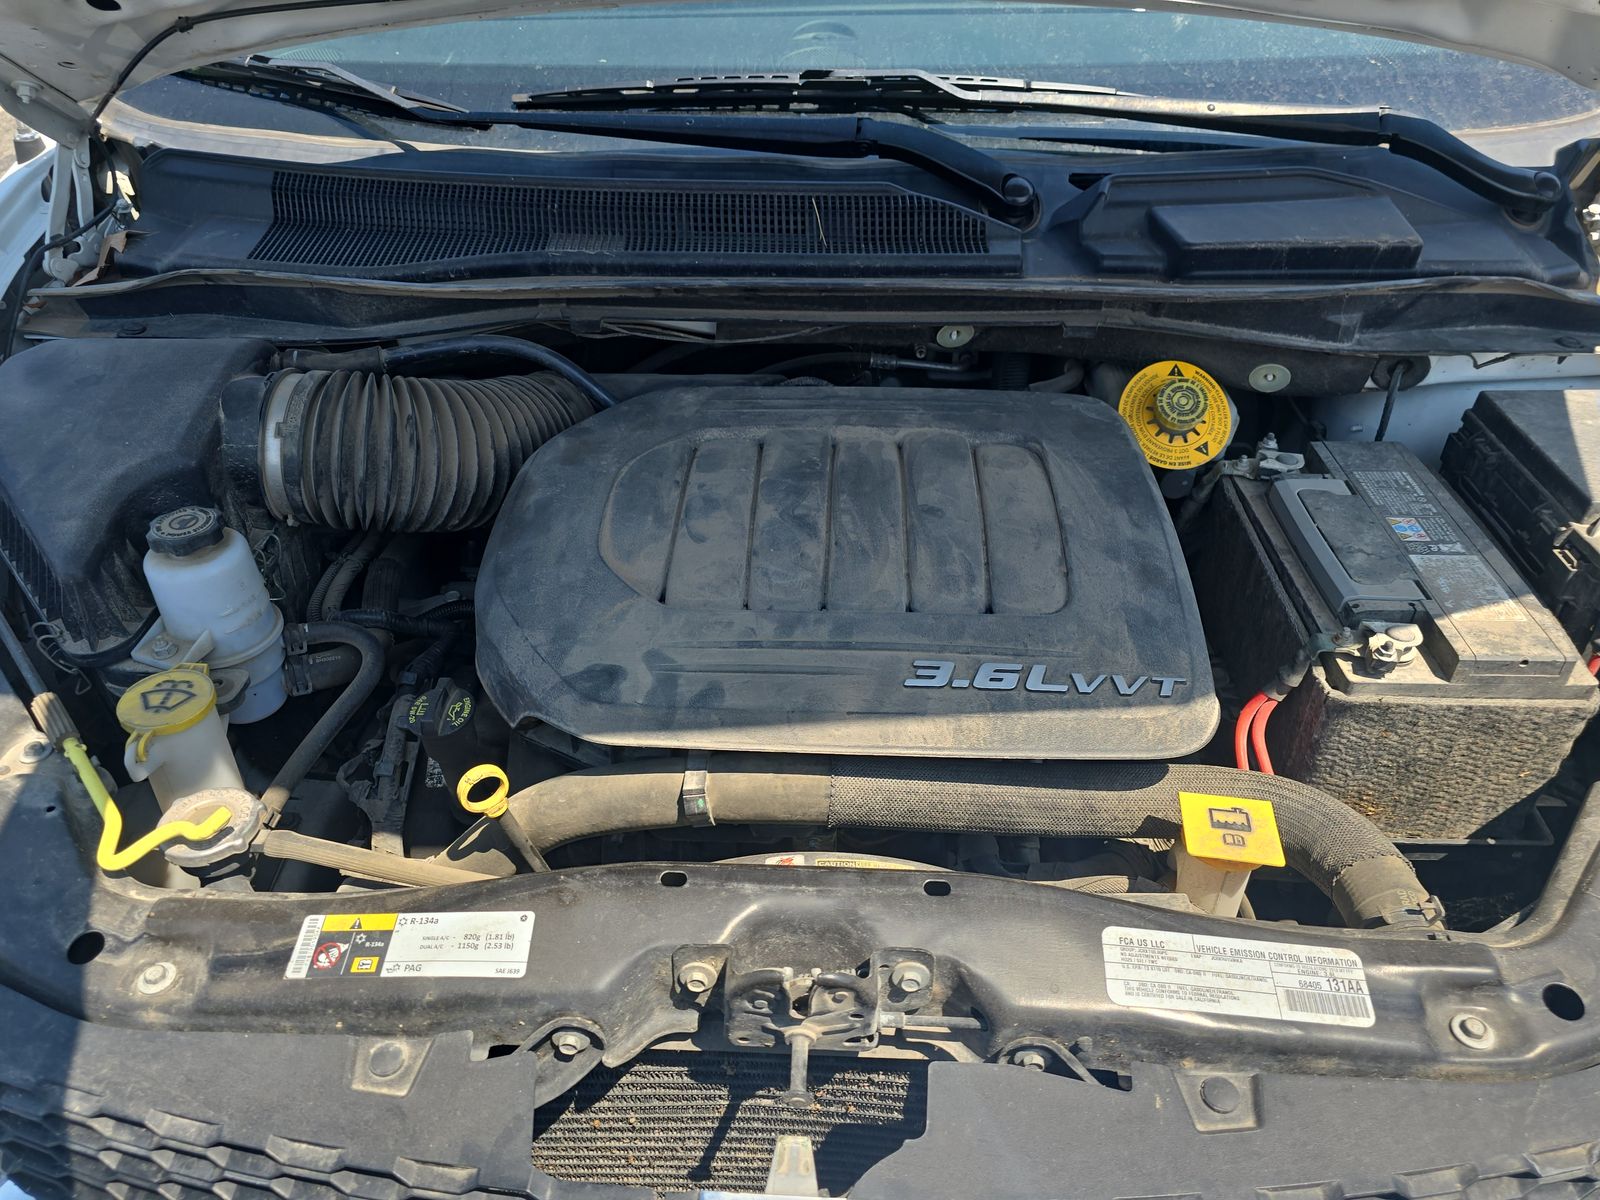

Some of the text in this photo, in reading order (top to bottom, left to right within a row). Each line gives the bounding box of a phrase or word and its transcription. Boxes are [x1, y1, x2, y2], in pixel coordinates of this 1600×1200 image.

[1070, 672, 1188, 697] VVT
[452, 697, 471, 726] ENGINE OIL
[464, 933, 480, 941] 820g
[486, 933, 503, 941] (1.81
[505, 932, 515, 941] lb)
[1119, 937, 1134, 945] FCA
[1151, 940, 1165, 948] LLC
[1196, 944, 1358, 967] VEHICLE EMISSION CONTROL INFORMATION
[404, 964, 422, 972] PAG
[1326, 978, 1364, 993] 131AA
